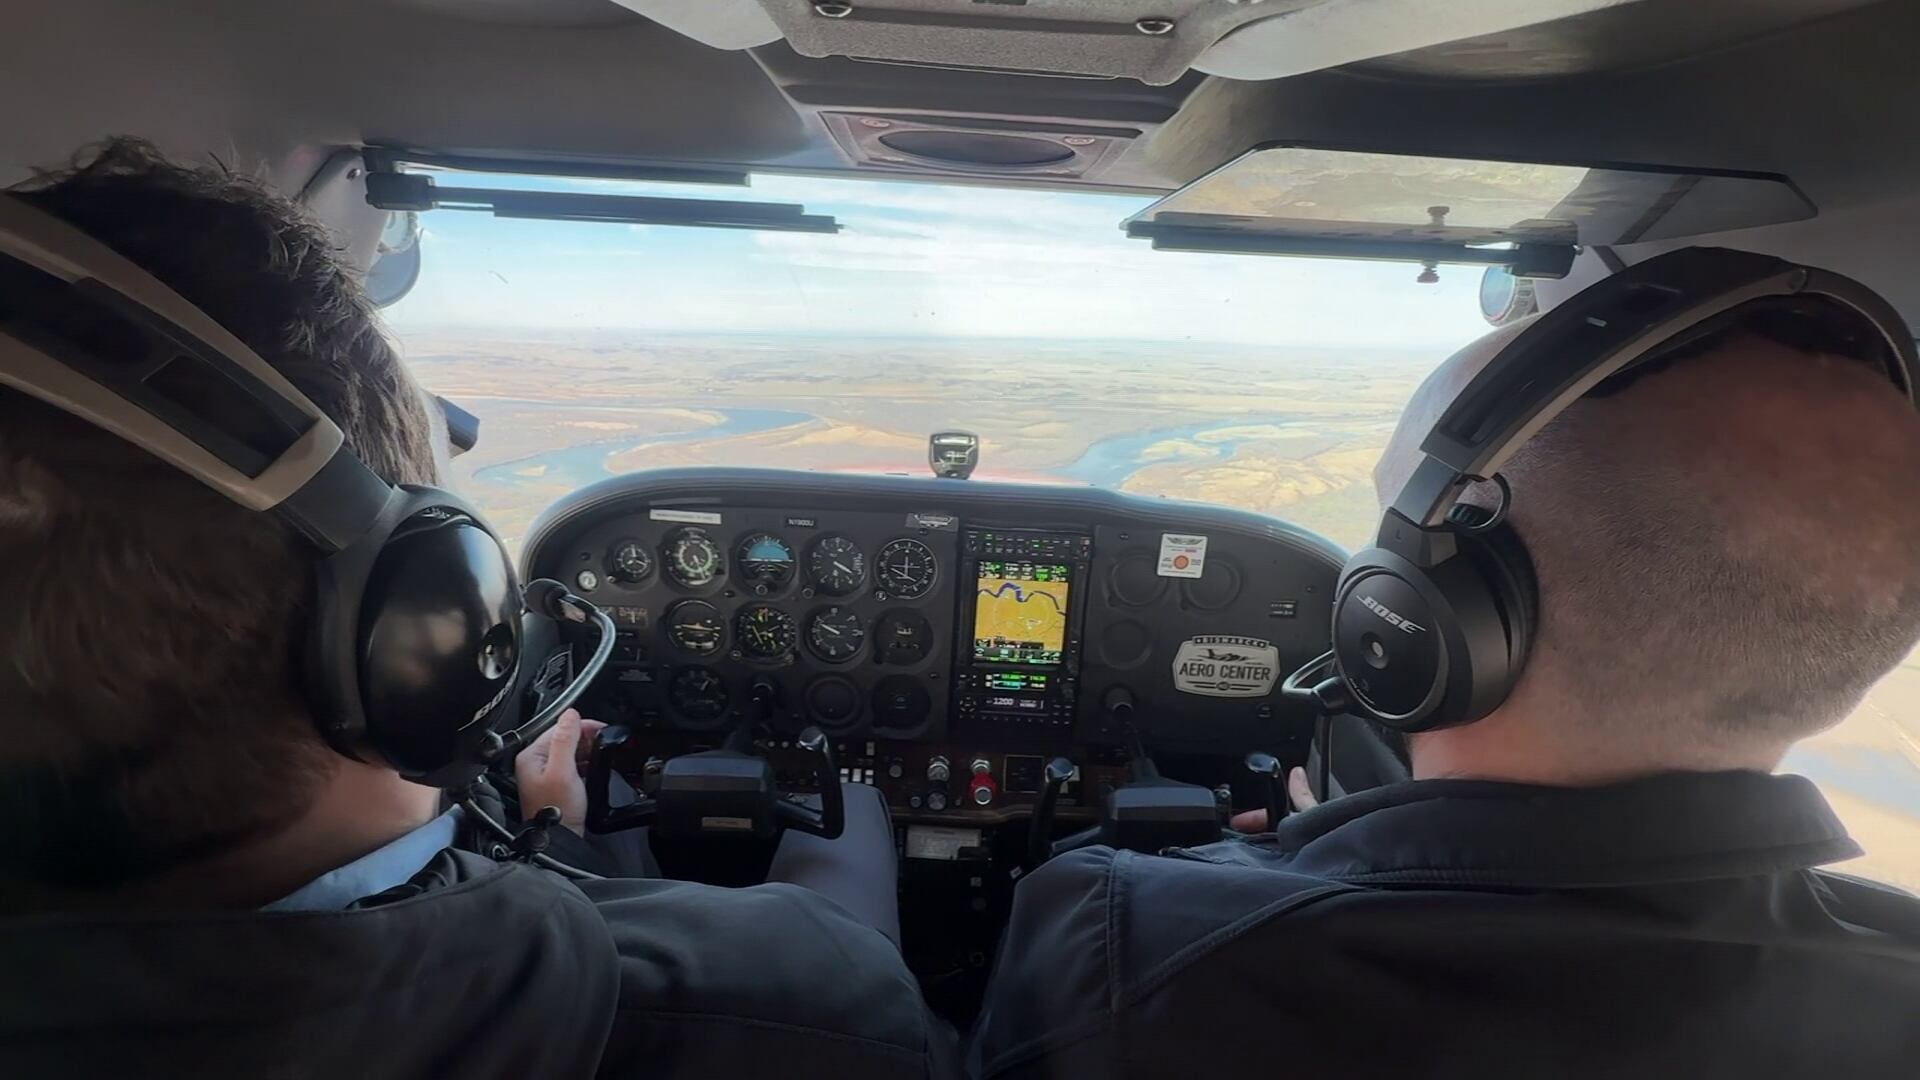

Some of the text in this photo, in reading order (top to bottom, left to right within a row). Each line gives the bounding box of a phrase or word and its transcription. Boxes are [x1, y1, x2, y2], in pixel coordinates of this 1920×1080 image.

[1356, 595, 1427, 634] BOSE
[1179, 662, 1272, 681] AERO CENTER
